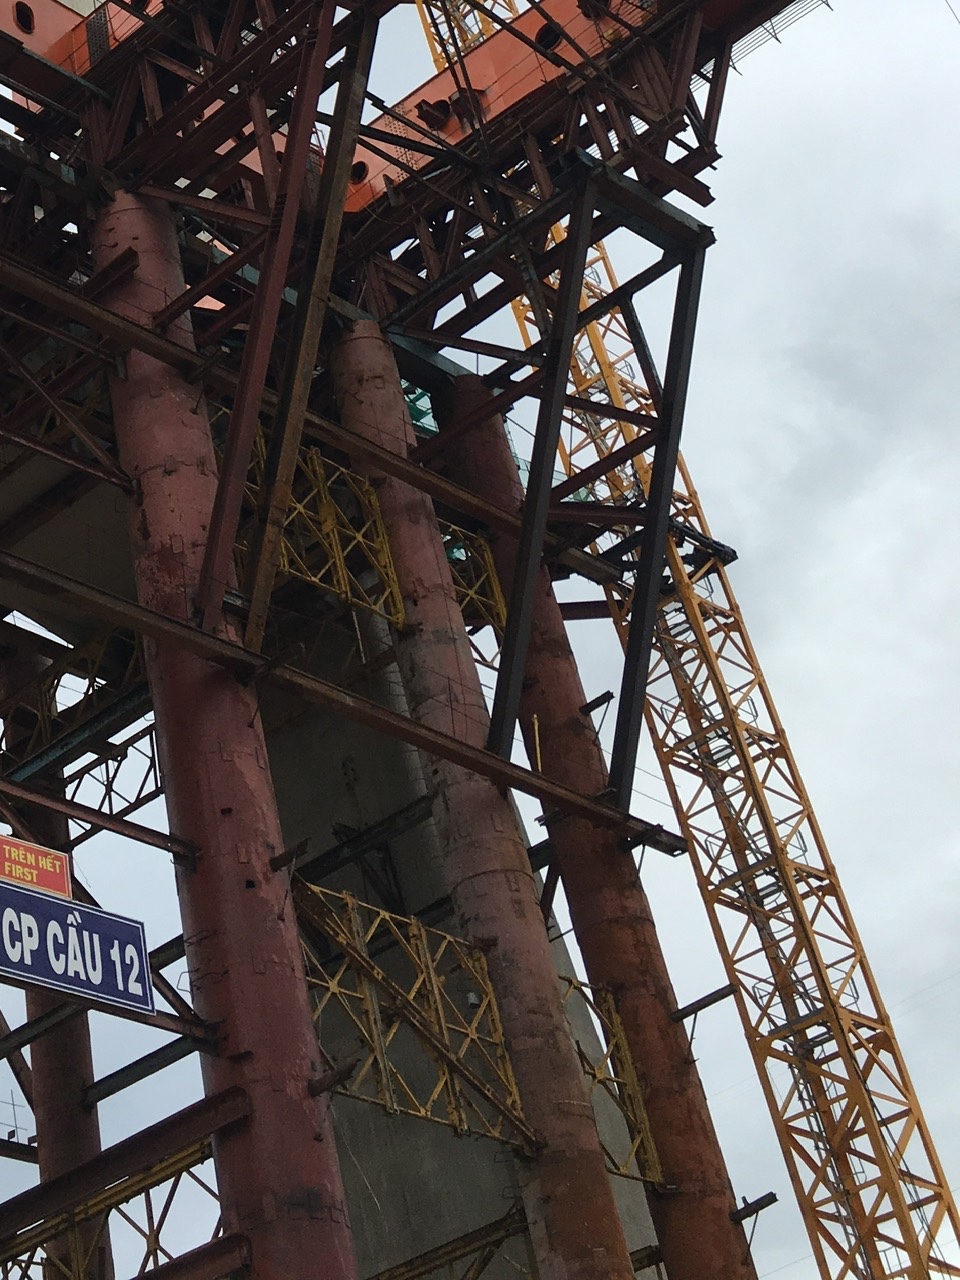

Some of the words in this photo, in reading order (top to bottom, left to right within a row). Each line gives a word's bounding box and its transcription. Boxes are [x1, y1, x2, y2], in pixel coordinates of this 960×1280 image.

[3, 845, 35, 866] TRÊN
[39, 855, 61, 873] HẾT
[4, 862, 38, 883] FIRST
[2, 908, 39, 966] CP
[46, 910, 102, 985] CẦU
[110, 939, 143, 996] 12
